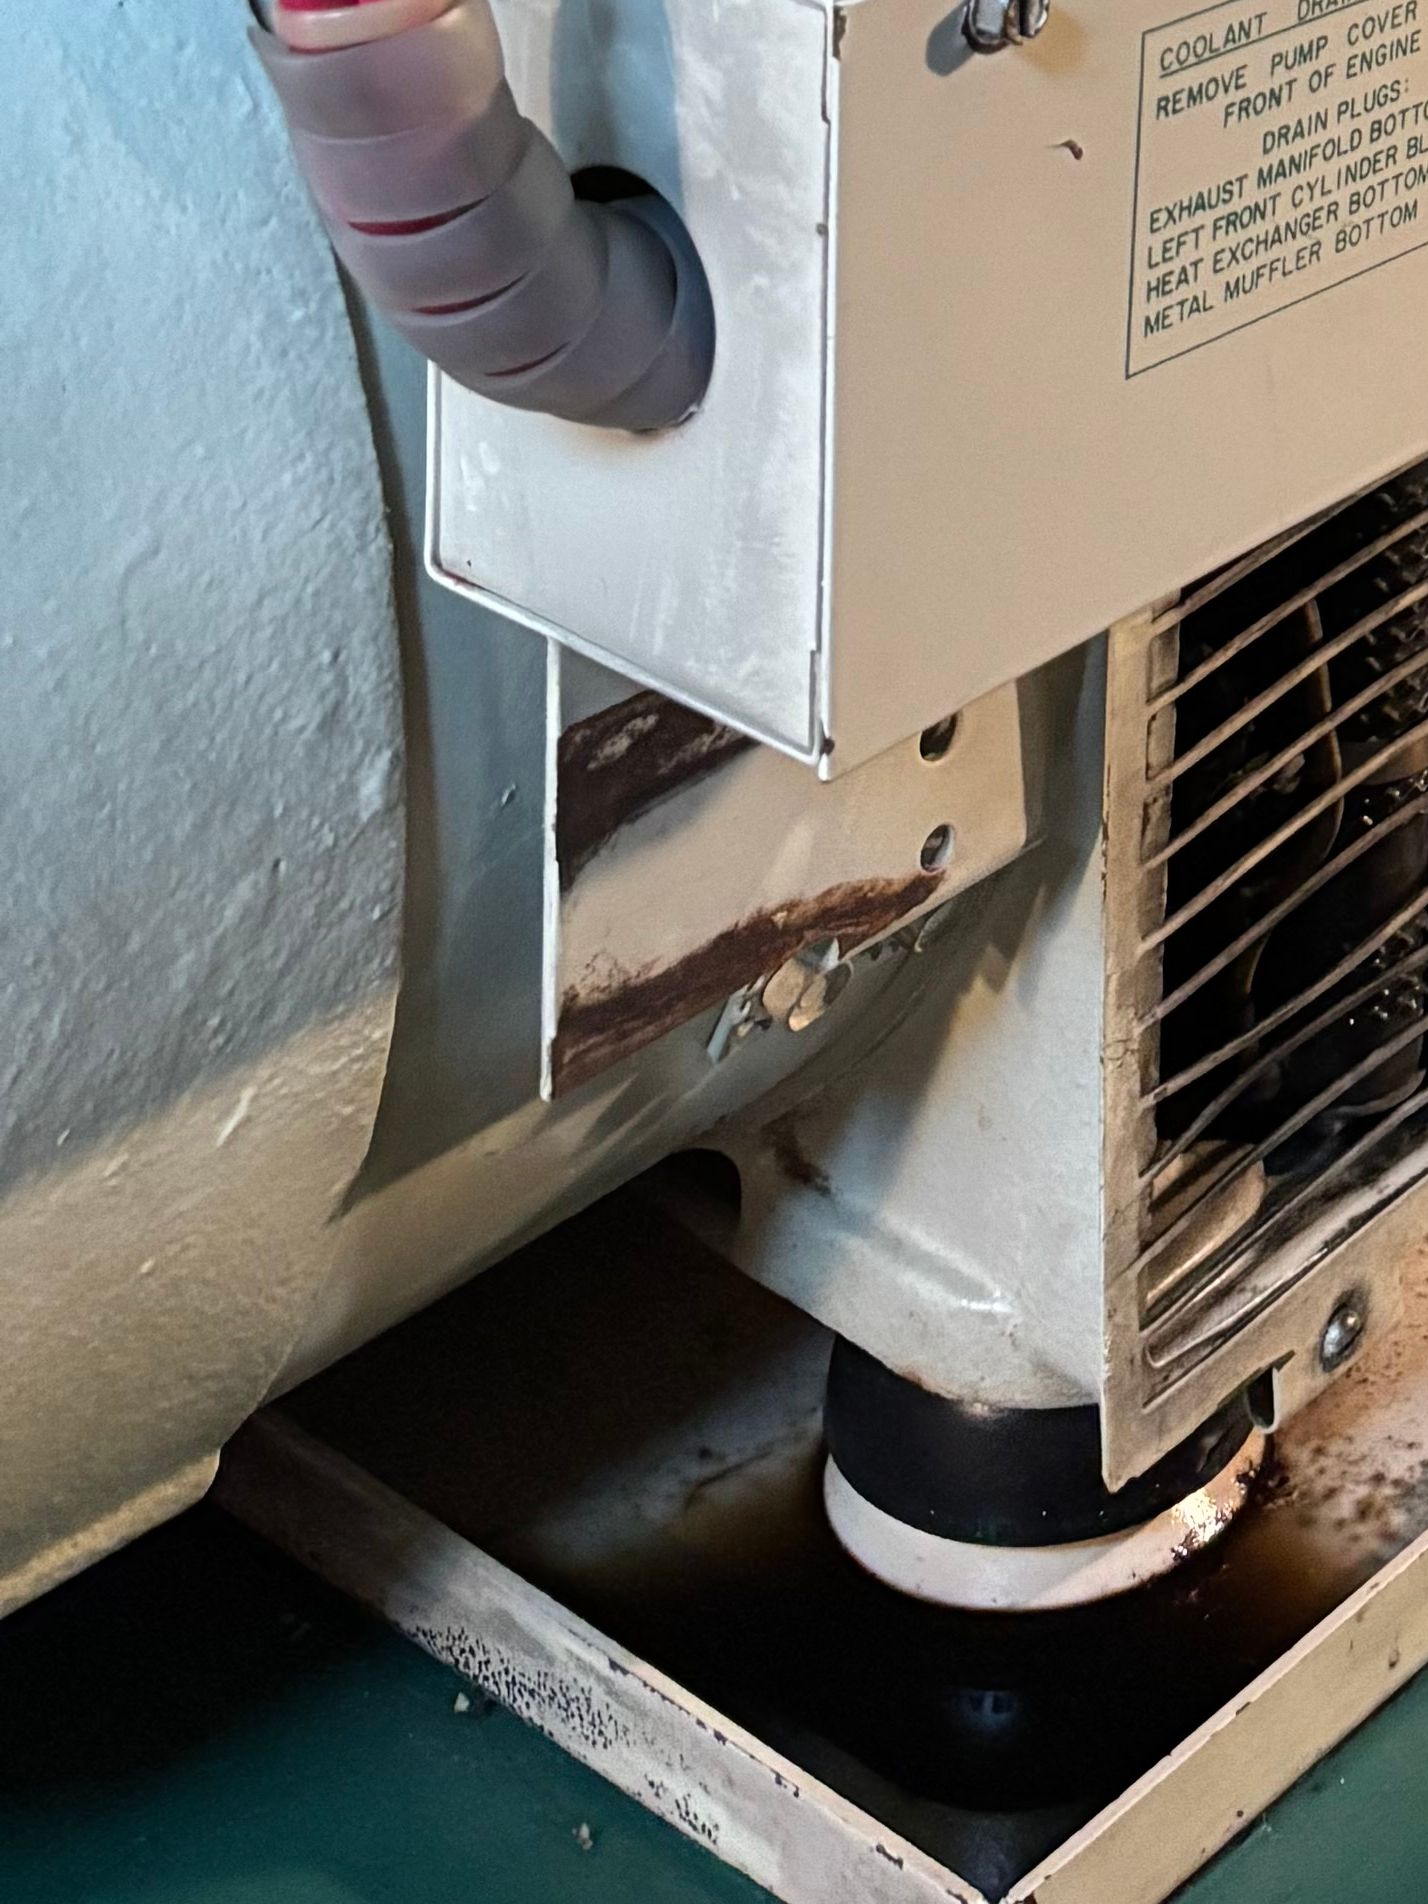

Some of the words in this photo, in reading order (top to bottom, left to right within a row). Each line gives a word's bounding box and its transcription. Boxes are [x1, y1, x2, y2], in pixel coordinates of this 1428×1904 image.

[1156, 63, 1248, 121] REMOVE
[1270, 35, 1329, 78] PUMP
[1347, 0, 1418, 46] COVER
[1160, 11, 1268, 72] COOLANT
[1223, 78, 1298, 129] FRONT
[1308, 63, 1337, 92] OF
[1346, 29, 1422, 80] ENGINE
[1262, 108, 1329, 156] DRAIN
[1336, 77, 1409, 124] PLUGS:
[1147, 224, 1205, 270] LEFT
[1212, 192, 1282, 241] FRONT
[1291, 144, 1399, 209] CYLINDER
[1150, 173, 1249, 234] EXHAUST
[1257, 127, 1363, 190] MANIFOLD
[1144, 290, 1214, 339] METAL
[1223, 240, 1322, 303] MUFFLER
[1334, 198, 1418, 254] BOTTOM
[1146, 258, 1205, 304] HEAT
[1212, 201, 1340, 274] EXCHANGER
